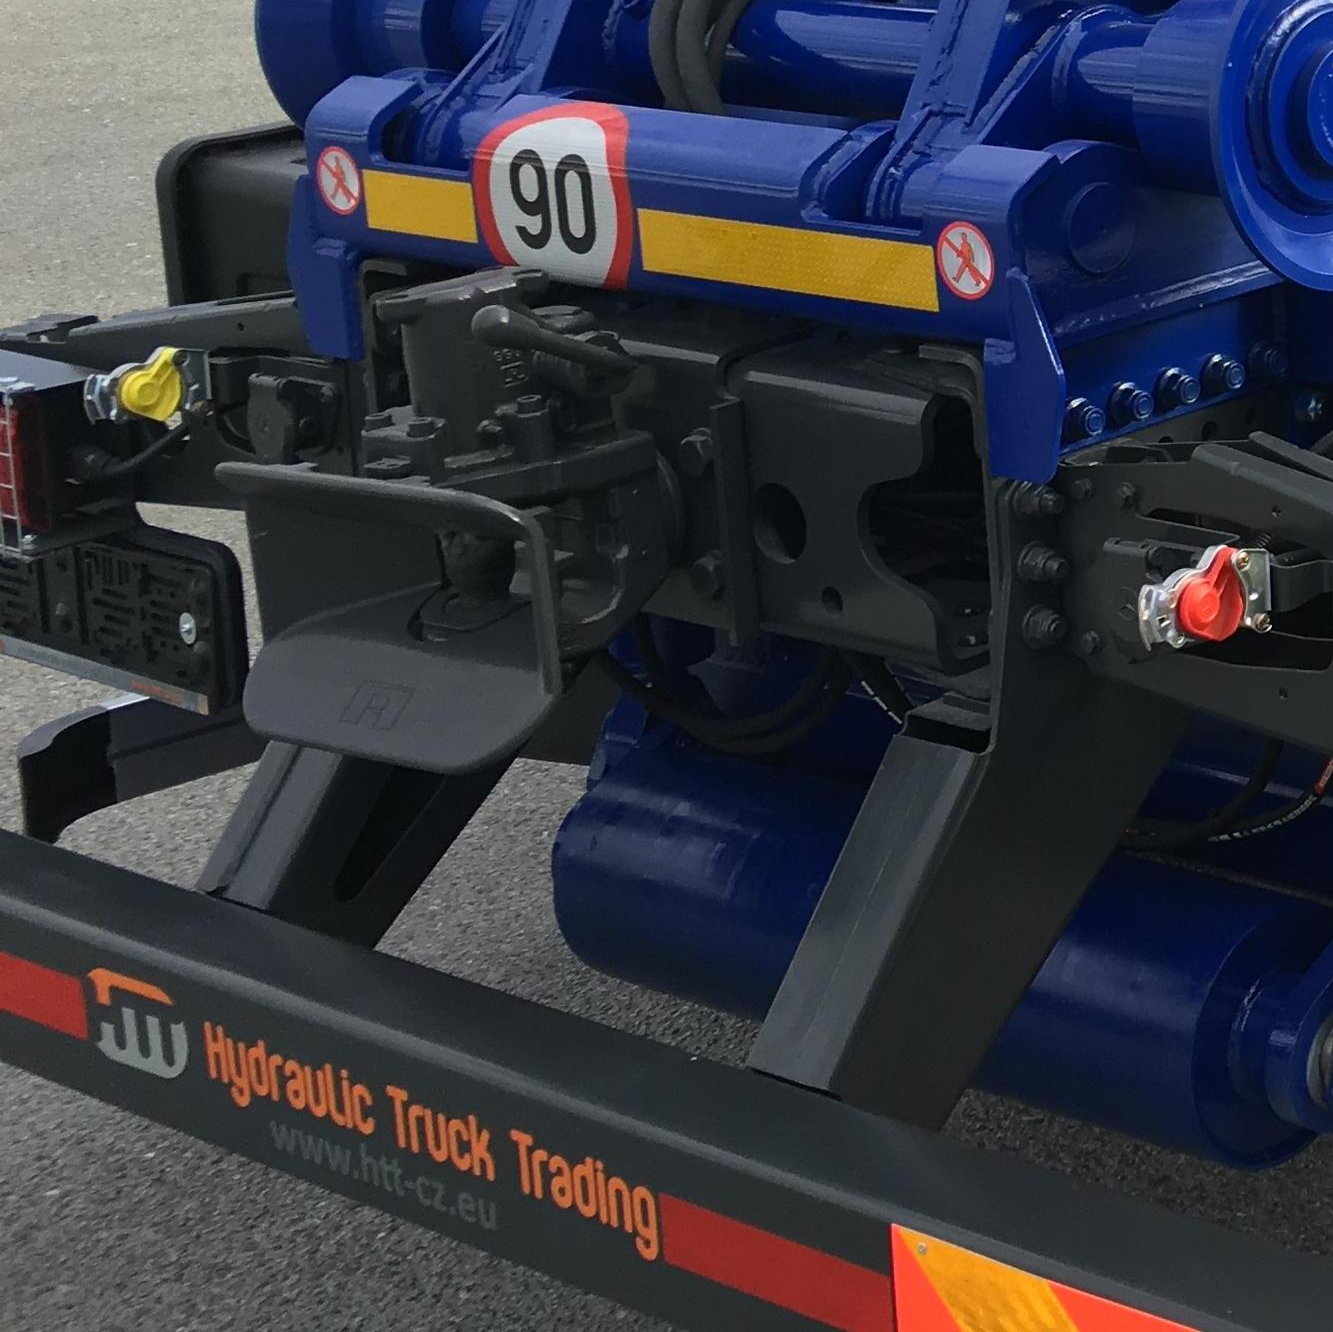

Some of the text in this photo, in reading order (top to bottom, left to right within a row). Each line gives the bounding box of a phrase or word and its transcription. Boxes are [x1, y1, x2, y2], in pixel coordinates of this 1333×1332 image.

[507, 148, 597, 255] 90
[204, 1021, 660, 1261] Hydraulic Truck Trading
[270, 1117, 499, 1232] www.htt-cz.eu
